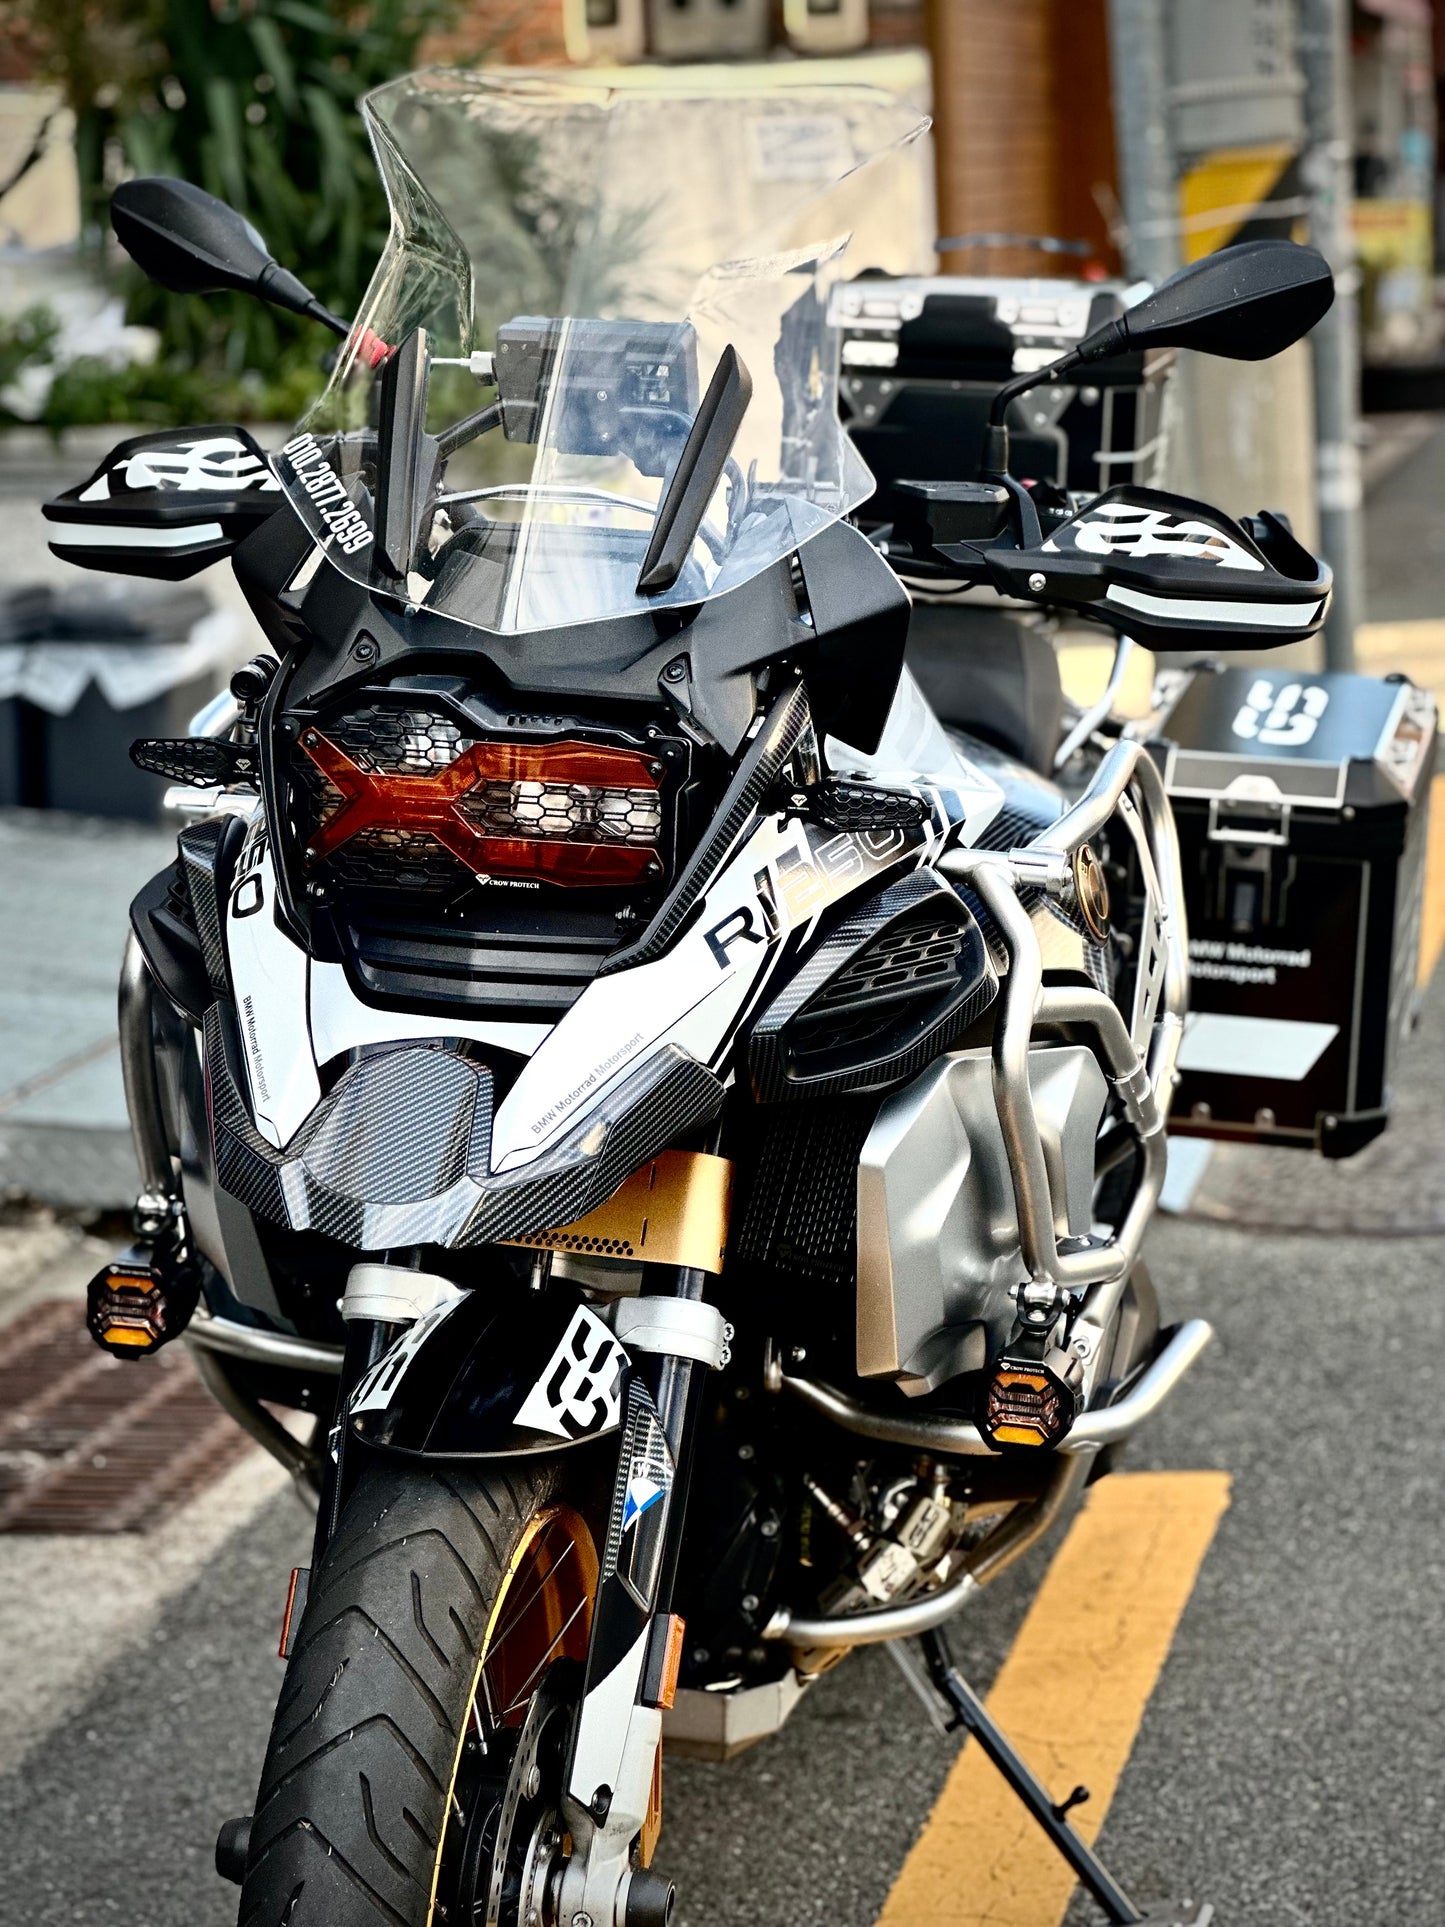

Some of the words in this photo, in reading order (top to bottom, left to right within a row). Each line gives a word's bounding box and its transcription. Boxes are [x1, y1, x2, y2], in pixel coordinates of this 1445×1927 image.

[283, 432, 375, 554] 010.2877.2699
[488, 879, 509, 887] CROW
[509, 881, 540, 889] PROTECH
[1188, 940, 1226, 960] MW
[1226, 942, 1312, 968] Motorrad
[1187, 960, 1277, 985] otorsport
[243, 995, 255, 1017] BMW
[247, 1016, 261, 1055] Motorrad
[253, 1053, 272, 1103] Motorsport
[531, 1109, 557, 1134] BMW
[554, 1073, 597, 1112] Motorrad
[594, 1032, 645, 1076] Motorsport
